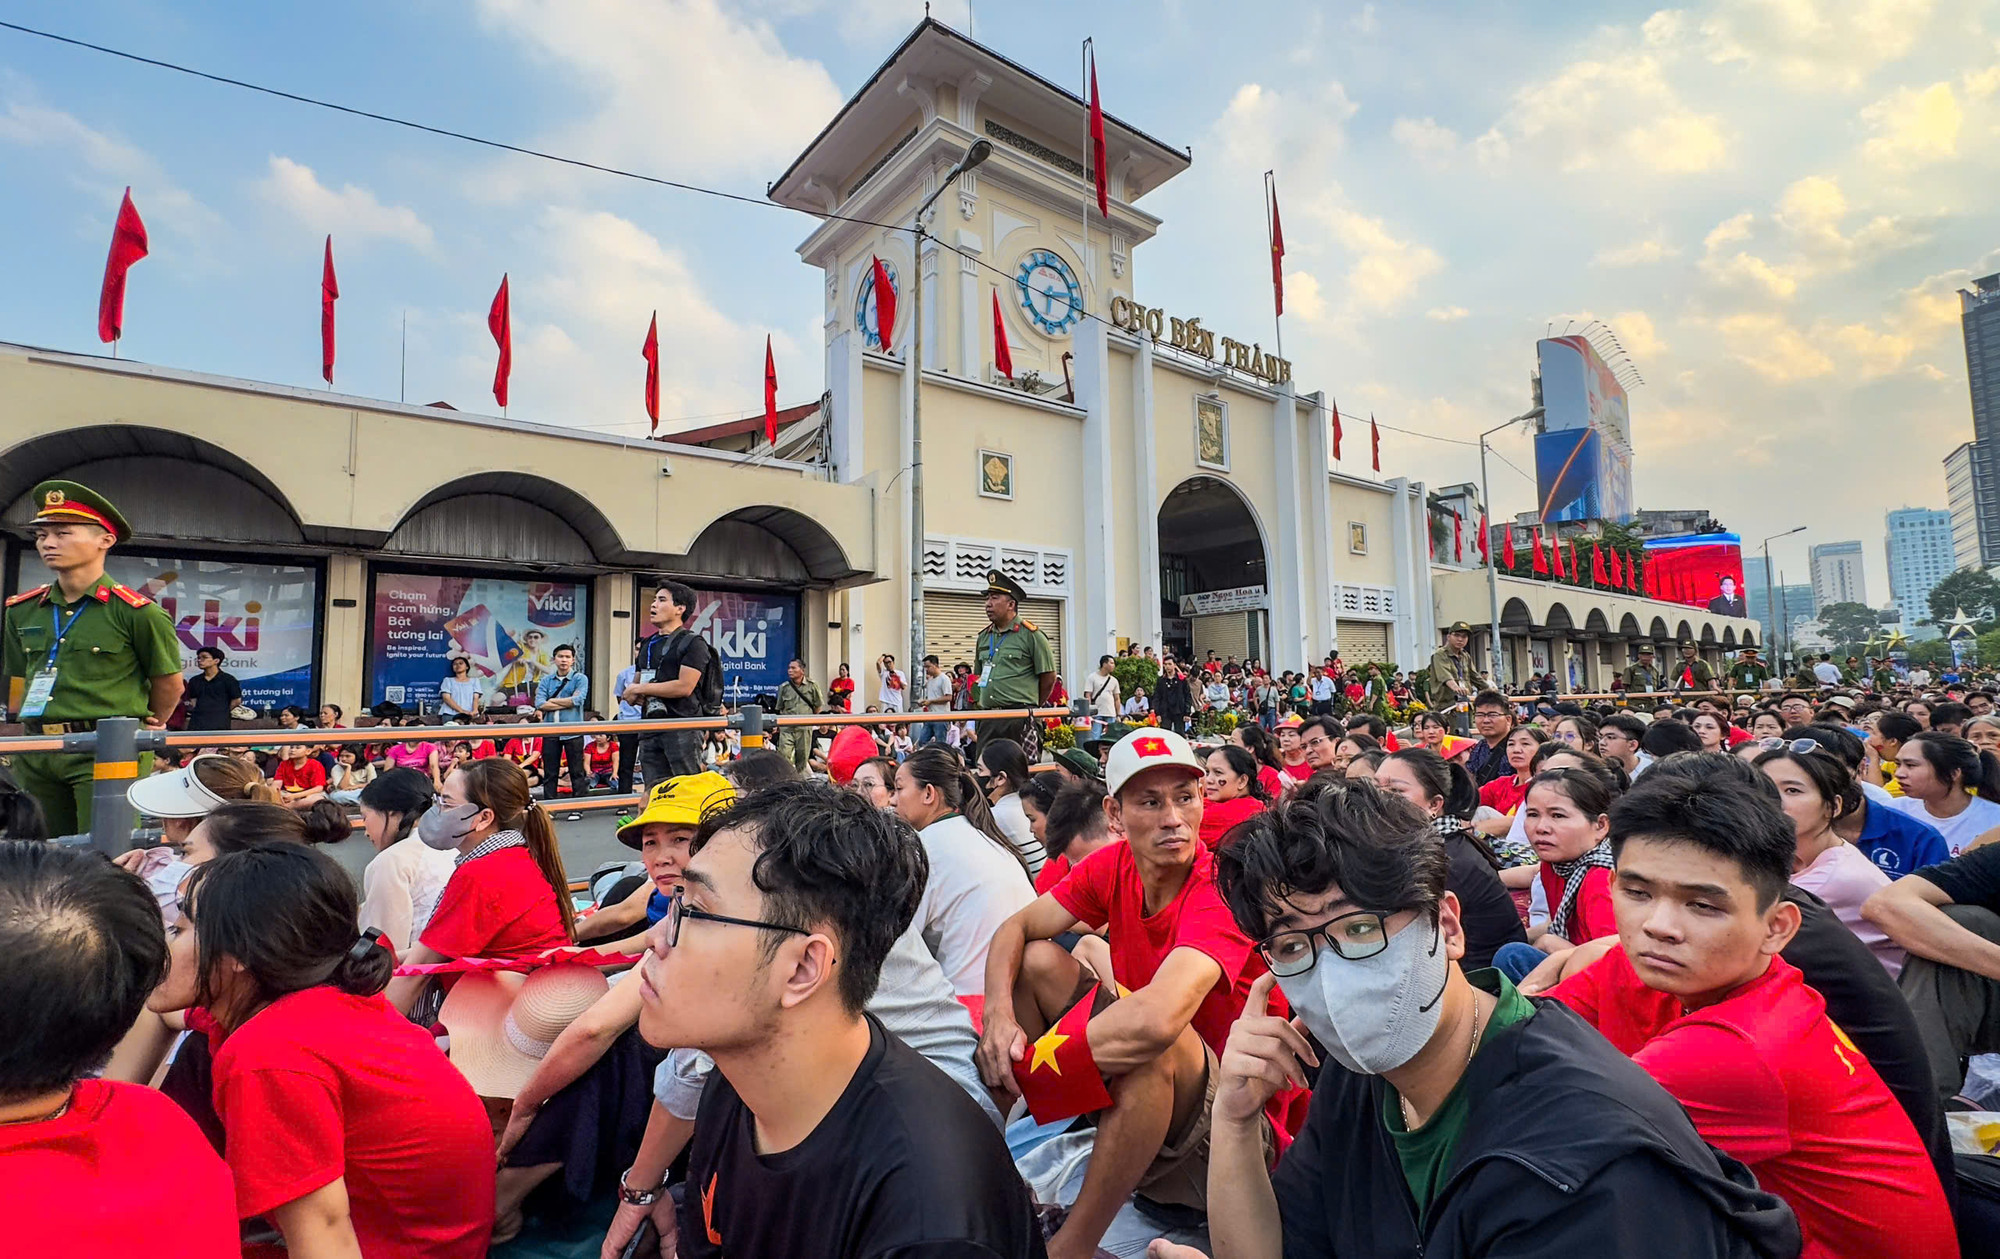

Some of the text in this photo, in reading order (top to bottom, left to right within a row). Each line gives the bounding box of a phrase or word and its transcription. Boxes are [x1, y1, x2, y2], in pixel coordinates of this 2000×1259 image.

[1111, 295, 1292, 385] CHỢ BẾN THÀNH
[388, 590, 427, 603] Chạm
[529, 588, 573, 611] Vikki
[1212, 591, 1233, 600] Ngọc
[1235, 588, 1253, 596] Hoa
[388, 603, 417, 613] cảm
[387, 616, 412, 629] Bật
[387, 630, 444, 641] tương lai
[720, 661, 767, 671] igital Bank
[241, 688, 252, 697] ật
[253, 689, 281, 697] tương
